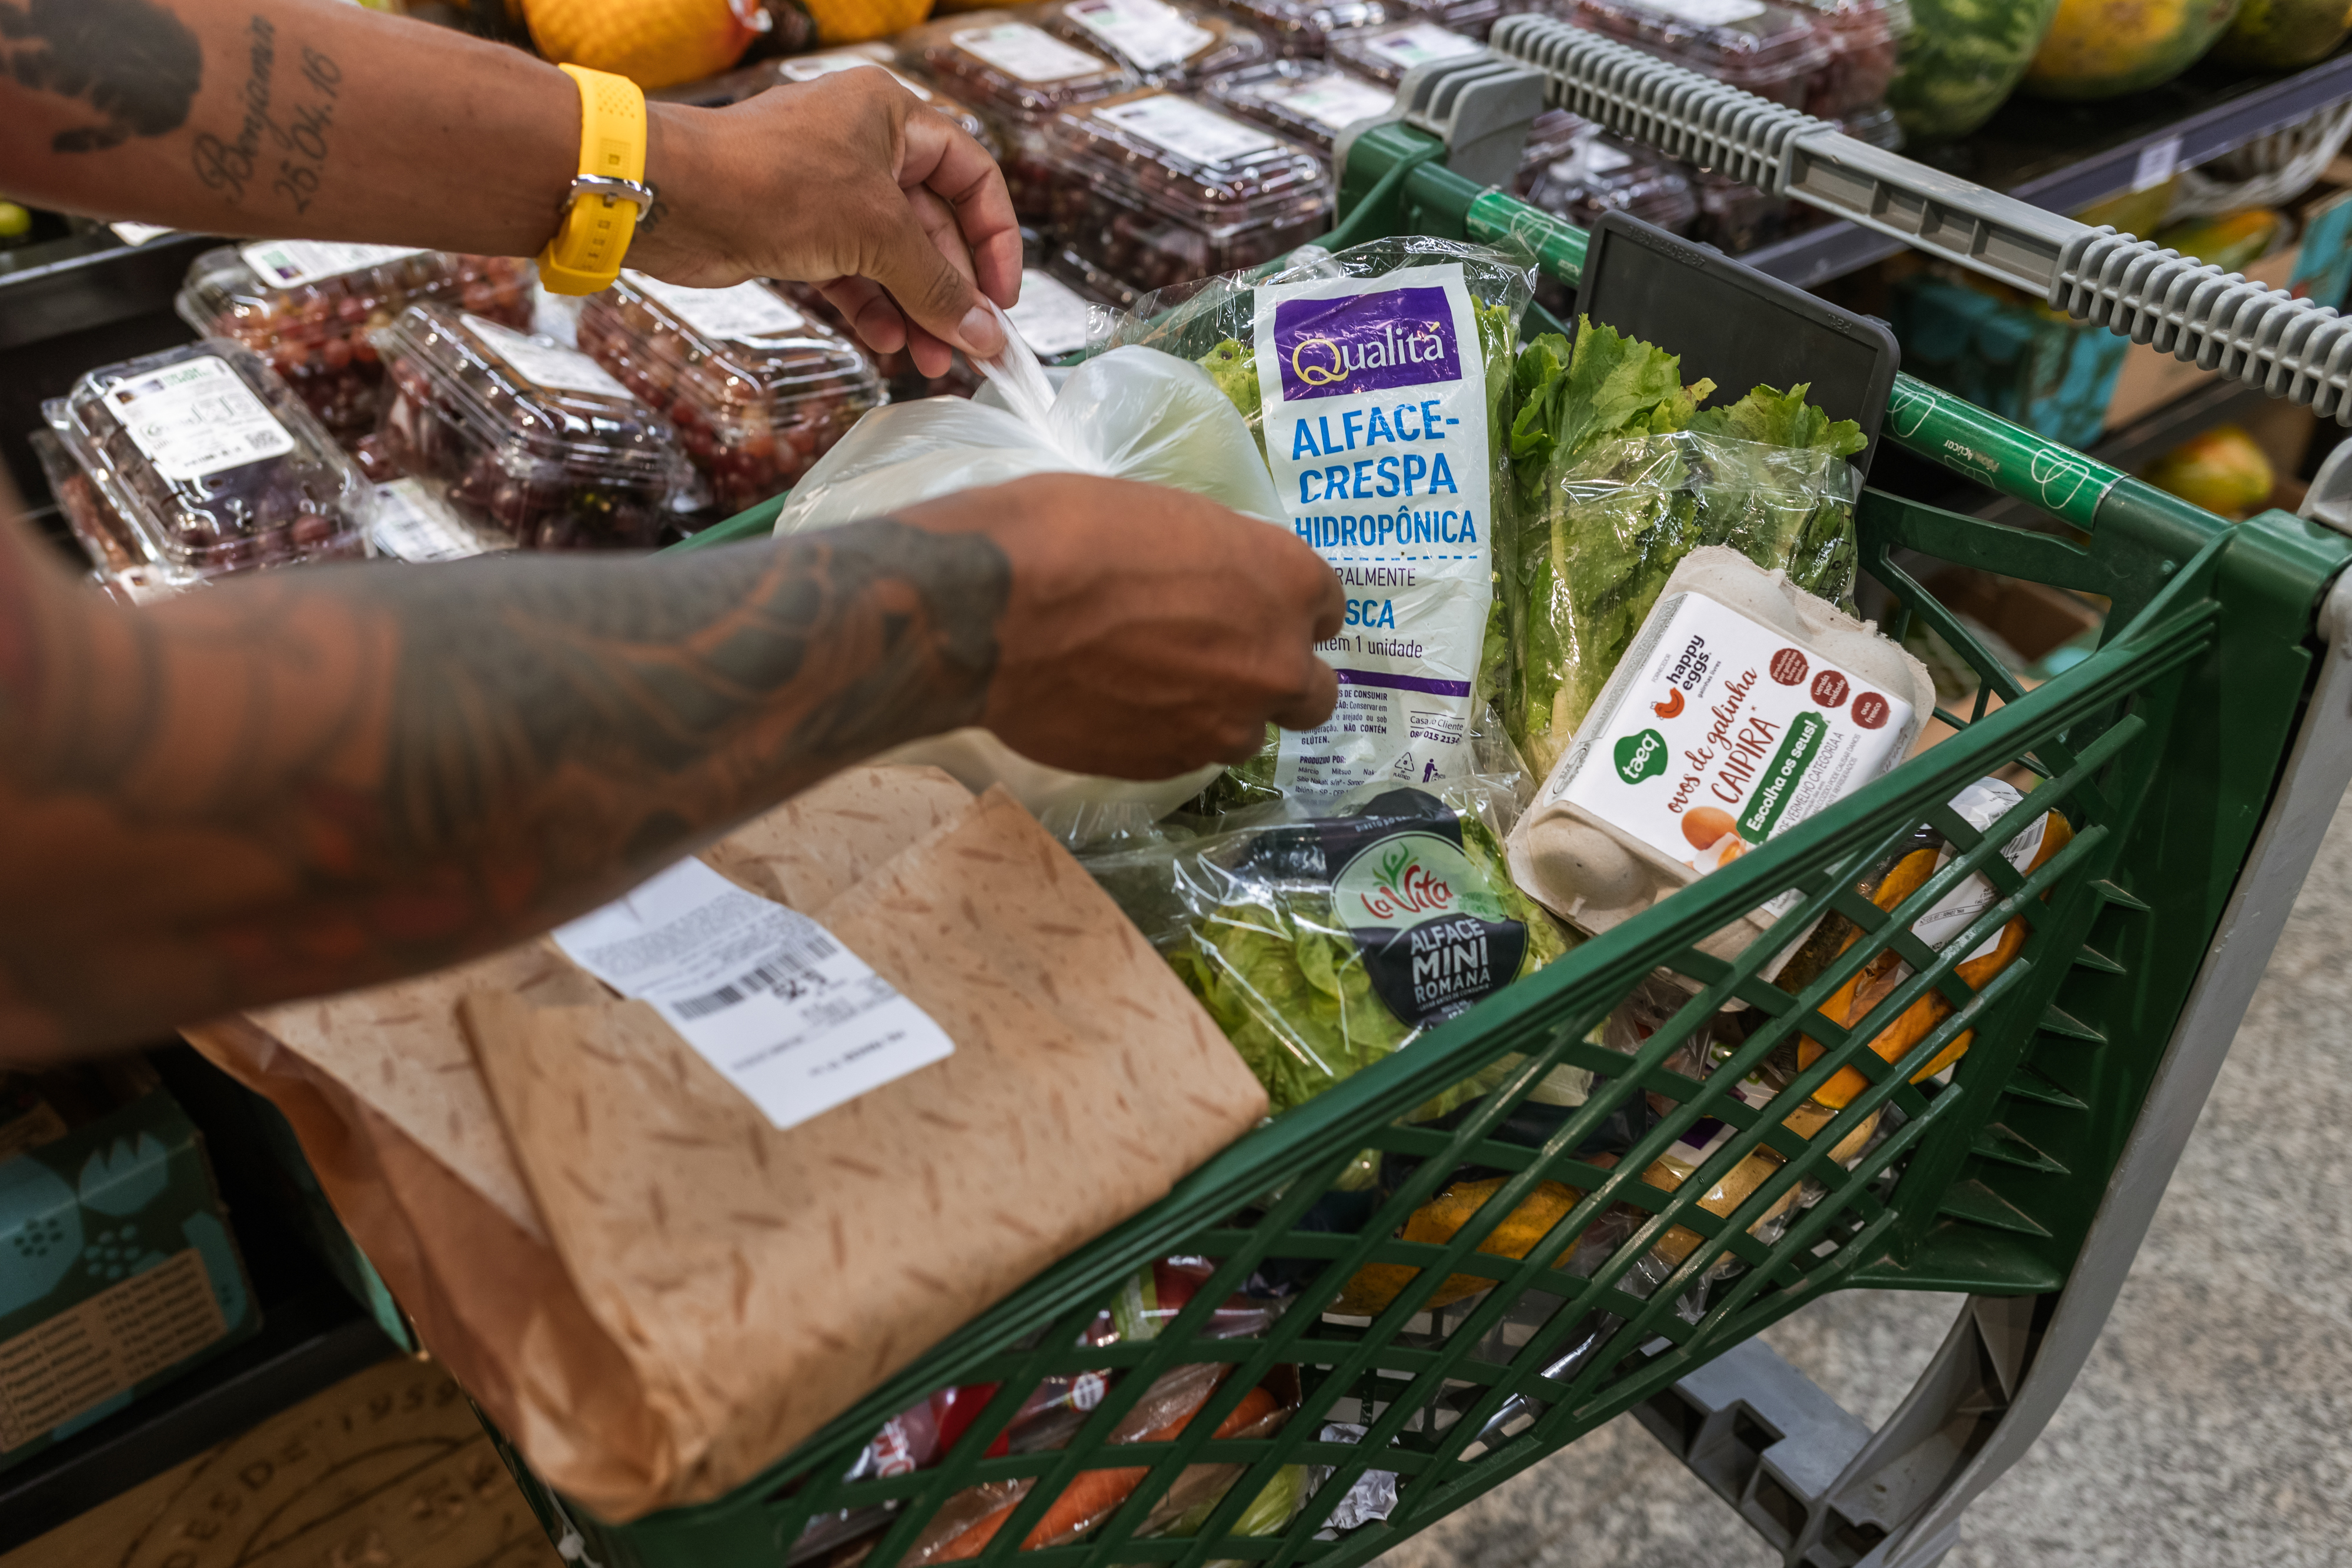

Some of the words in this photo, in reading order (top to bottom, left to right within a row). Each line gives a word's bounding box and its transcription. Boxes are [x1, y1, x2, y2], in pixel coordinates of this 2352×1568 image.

[1292, 321, 1445, 386] Qualitá
[1292, 400, 1459, 460] ALFACE-
[1944, 439, 1973, 460] Açúcar
[1299, 453, 1458, 504] CRESPA
[1295, 505, 1477, 548] HIDROPÔNICA
[1335, 568, 1416, 587] RALMENTE
[1345, 599, 1395, 629] SCA
[1356, 636, 1362, 653] 1
[1368, 638, 1423, 658] unidade
[1666, 635, 1705, 684] happy
[1698, 674, 1712, 698] galinhas
[1710, 660, 1722, 678] livres
[1823, 681, 1833, 696] por
[1828, 679, 1846, 706] unidade
[1344, 689, 1352, 698] DE
[1354, 690, 1388, 701] CONSUMIR
[1349, 701, 1378, 711] Conservar
[1342, 713, 1363, 722] arejado
[1377, 715, 1387, 723] sob
[1344, 723, 1357, 732] NÃO
[1360, 724, 1387, 734] CONTÉM
[1410, 716, 1428, 725] Casa
[1438, 718, 1464, 731] Cliente
[1865, 703, 1883, 724] fresco
[1301, 735, 1330, 745] GLÚTEN.
[1424, 731, 1439, 741] 015
[1668, 774, 1700, 813] ovos
[1685, 745, 1714, 771] de
[1707, 667, 1758, 750] galinha
[1300, 755, 1330, 764] PRODUZIDO
[1332, 755, 1347, 764] POR:
[1622, 733, 1660, 778] taeq
[1711, 717, 1780, 804] CAIPIRA
[1298, 767, 1319, 775] Márcio
[1746, 776, 1788, 831] Escolha
[1781, 758, 1797, 776] os
[1790, 719, 1818, 758] seus!
[1785, 781, 1815, 821] VERMELHO
[1808, 738, 1841, 782] CATEGORIA
[1379, 865, 1454, 913] Vita
[1411, 918, 1485, 955] ALFACE
[1412, 936, 1489, 985] MINI
[1414, 966, 1491, 1004] ROMANA
